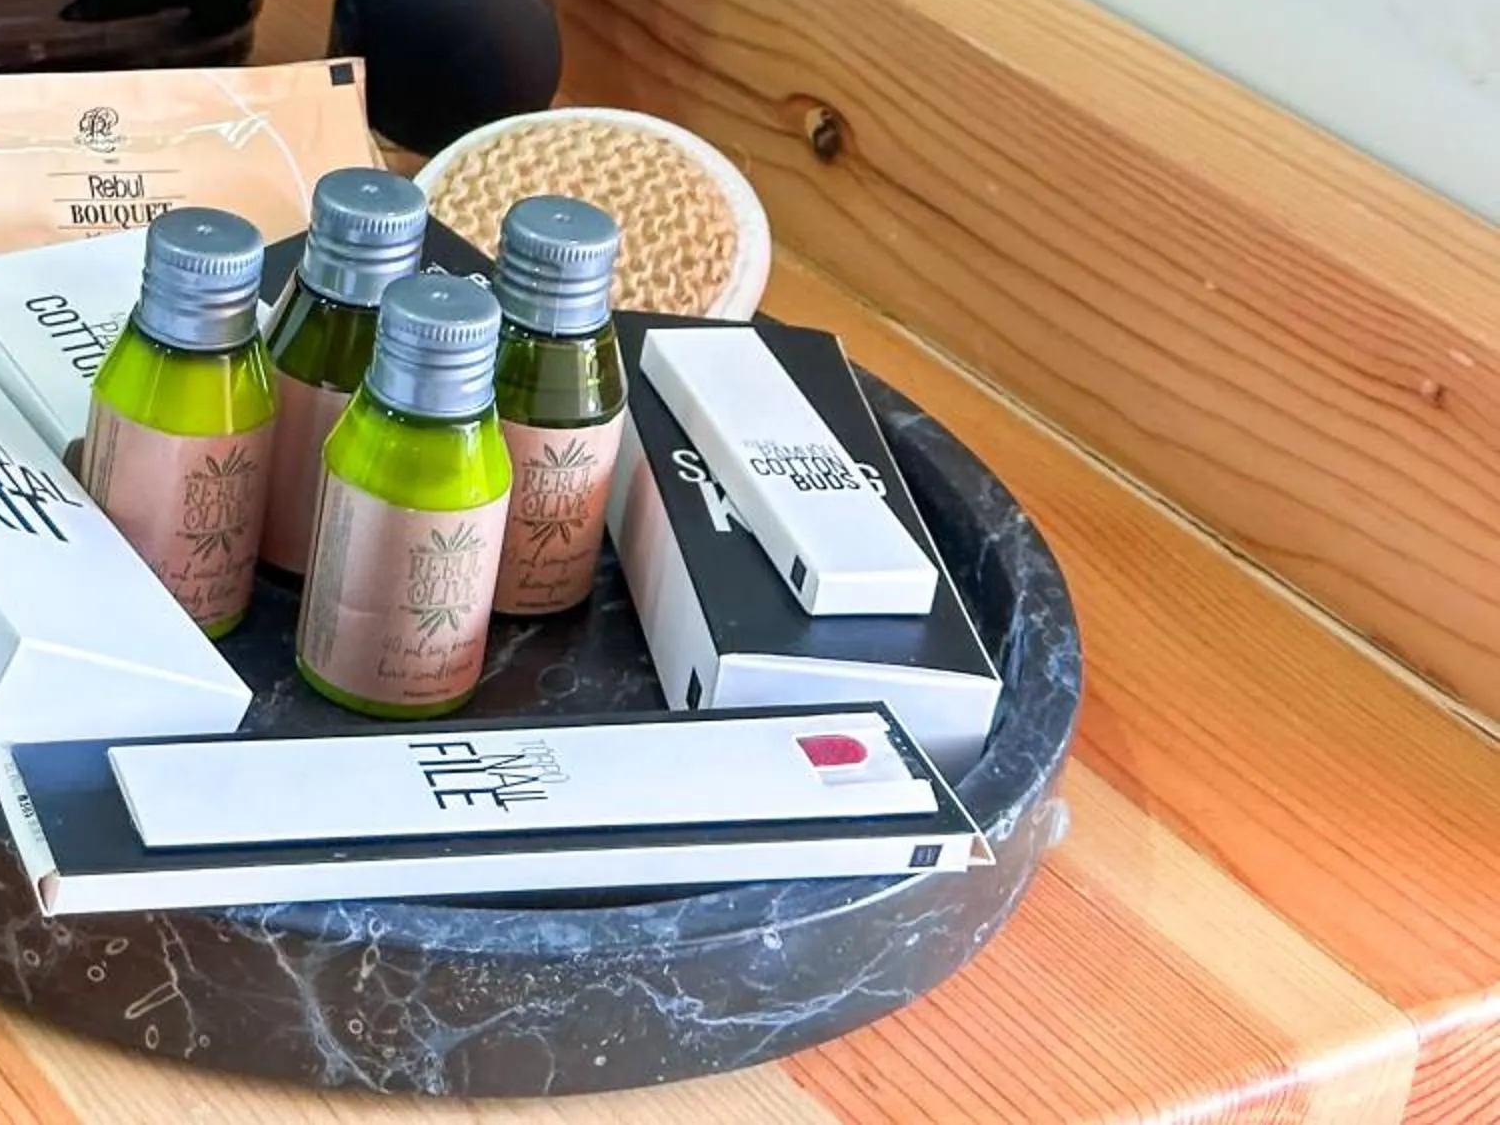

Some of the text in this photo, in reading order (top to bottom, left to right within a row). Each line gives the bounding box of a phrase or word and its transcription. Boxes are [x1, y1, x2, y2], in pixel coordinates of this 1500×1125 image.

[88, 173, 145, 199] Rebul
[25, 294, 106, 378] COTTO
[750, 456, 851, 477] COTTON
[790, 474, 861, 492] BUDS
[408, 741, 504, 811] FILE
[479, 752, 549, 813] NAIL
